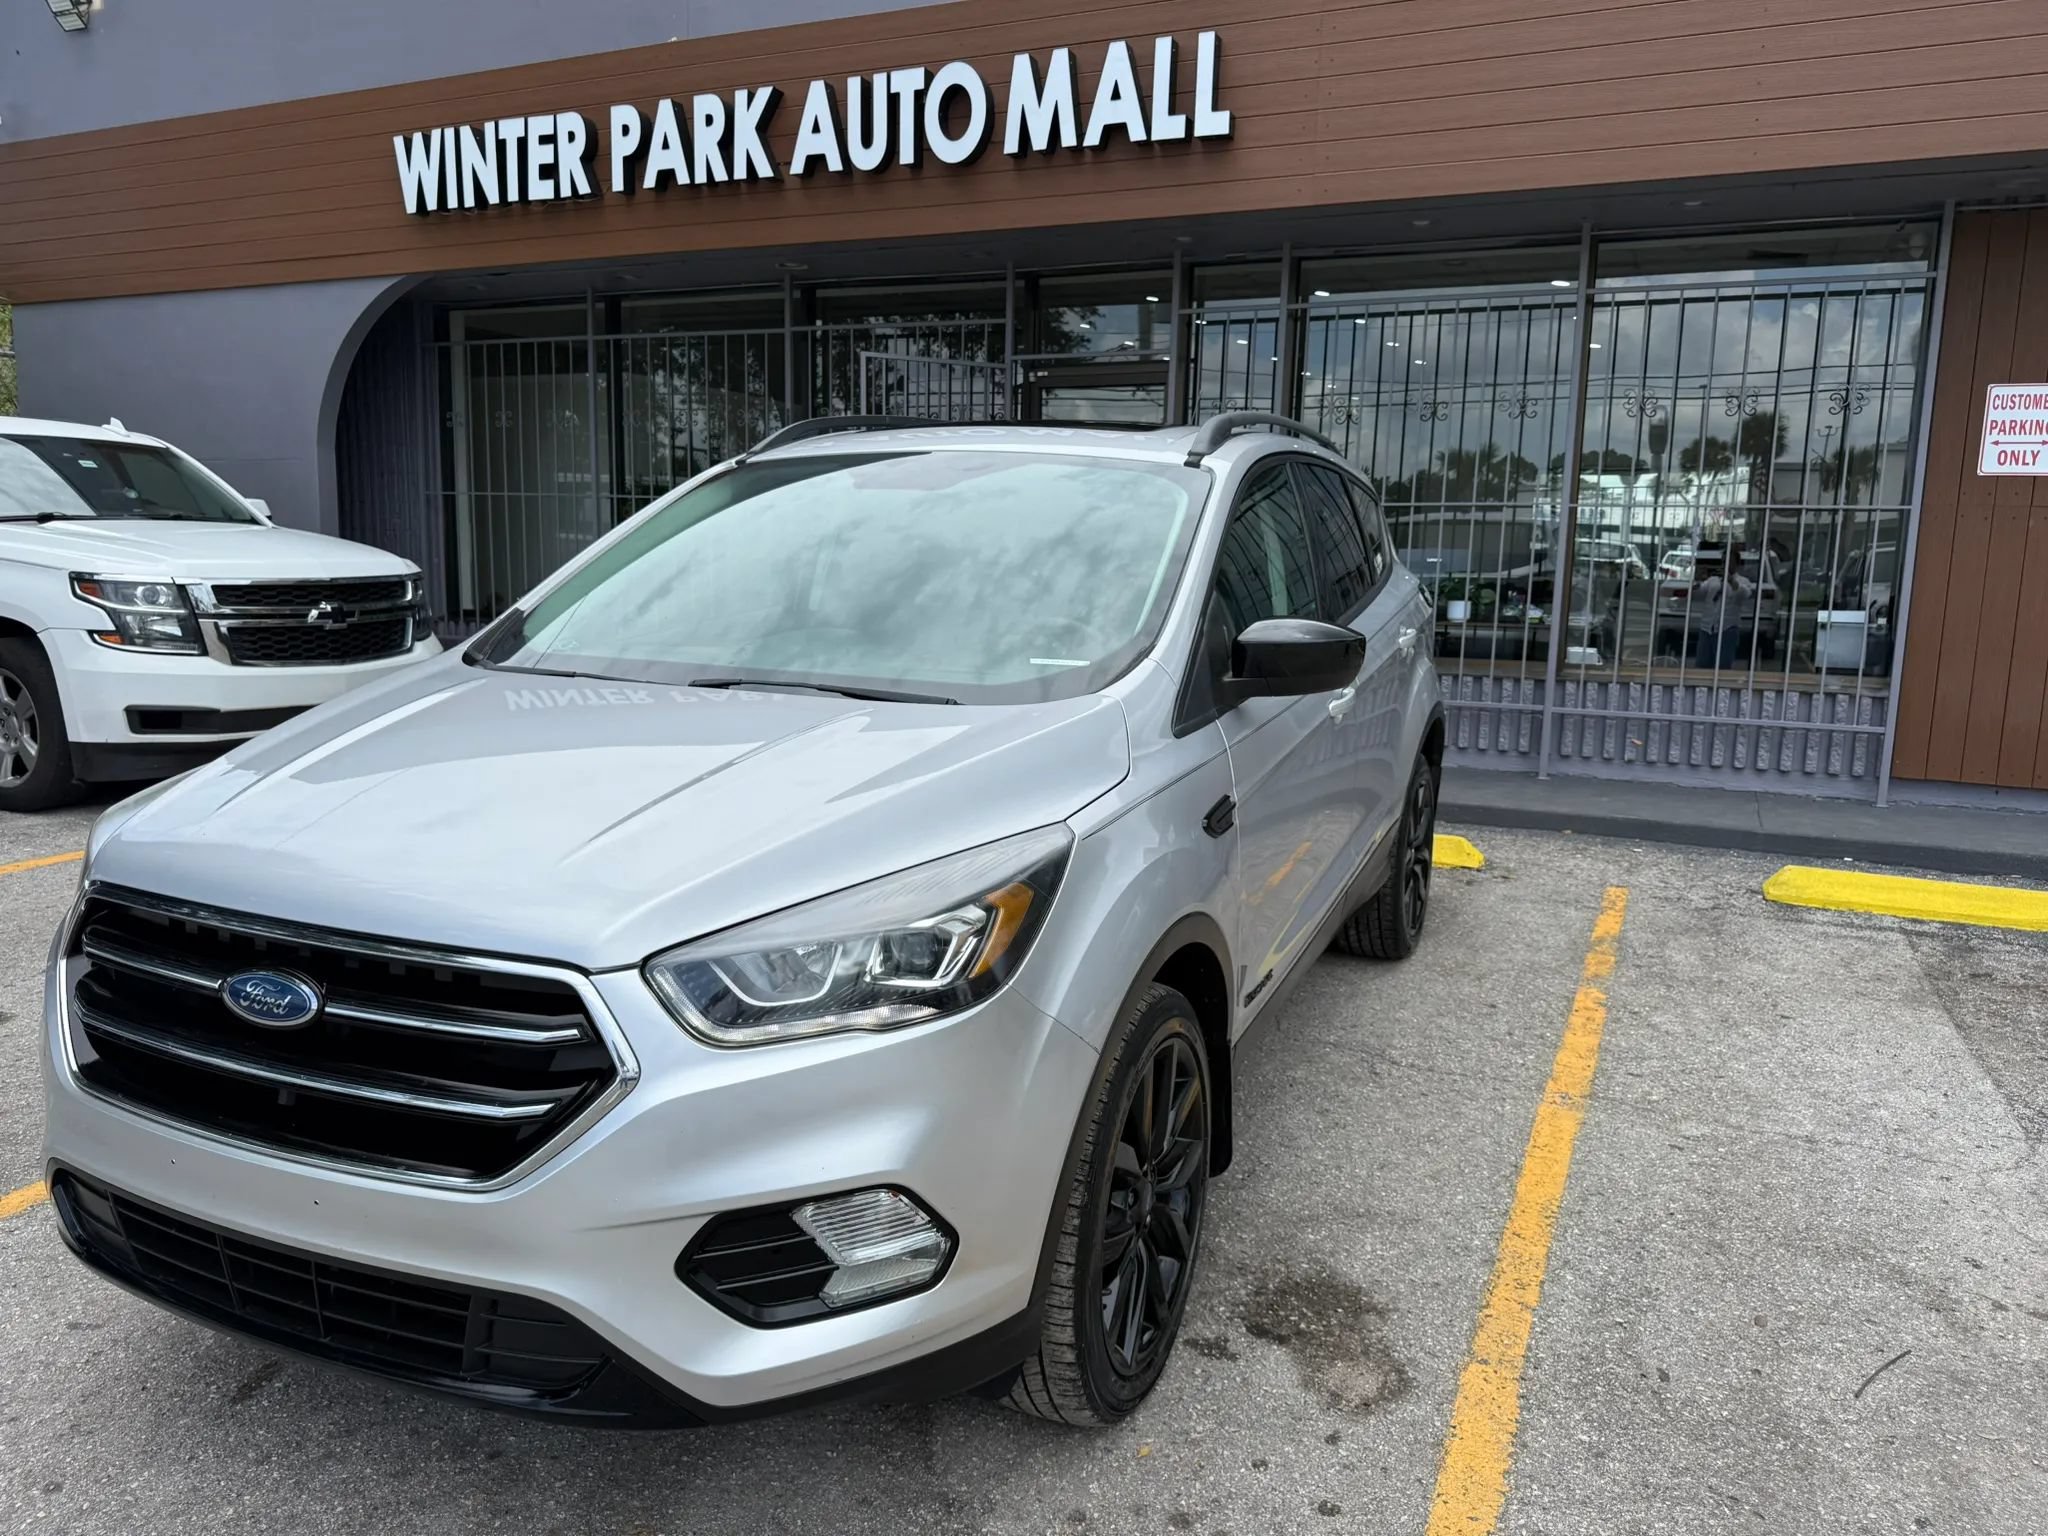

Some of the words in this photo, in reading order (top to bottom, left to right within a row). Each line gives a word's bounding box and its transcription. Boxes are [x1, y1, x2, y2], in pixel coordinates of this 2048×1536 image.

[393, 111, 593, 214] WINTER
[610, 86, 774, 192] PARK
[789, 61, 988, 175] AUTO
[1003, 30, 1231, 155] MALL
[1997, 450, 2041, 466] ONLY
[240, 980, 292, 1014] Ford
